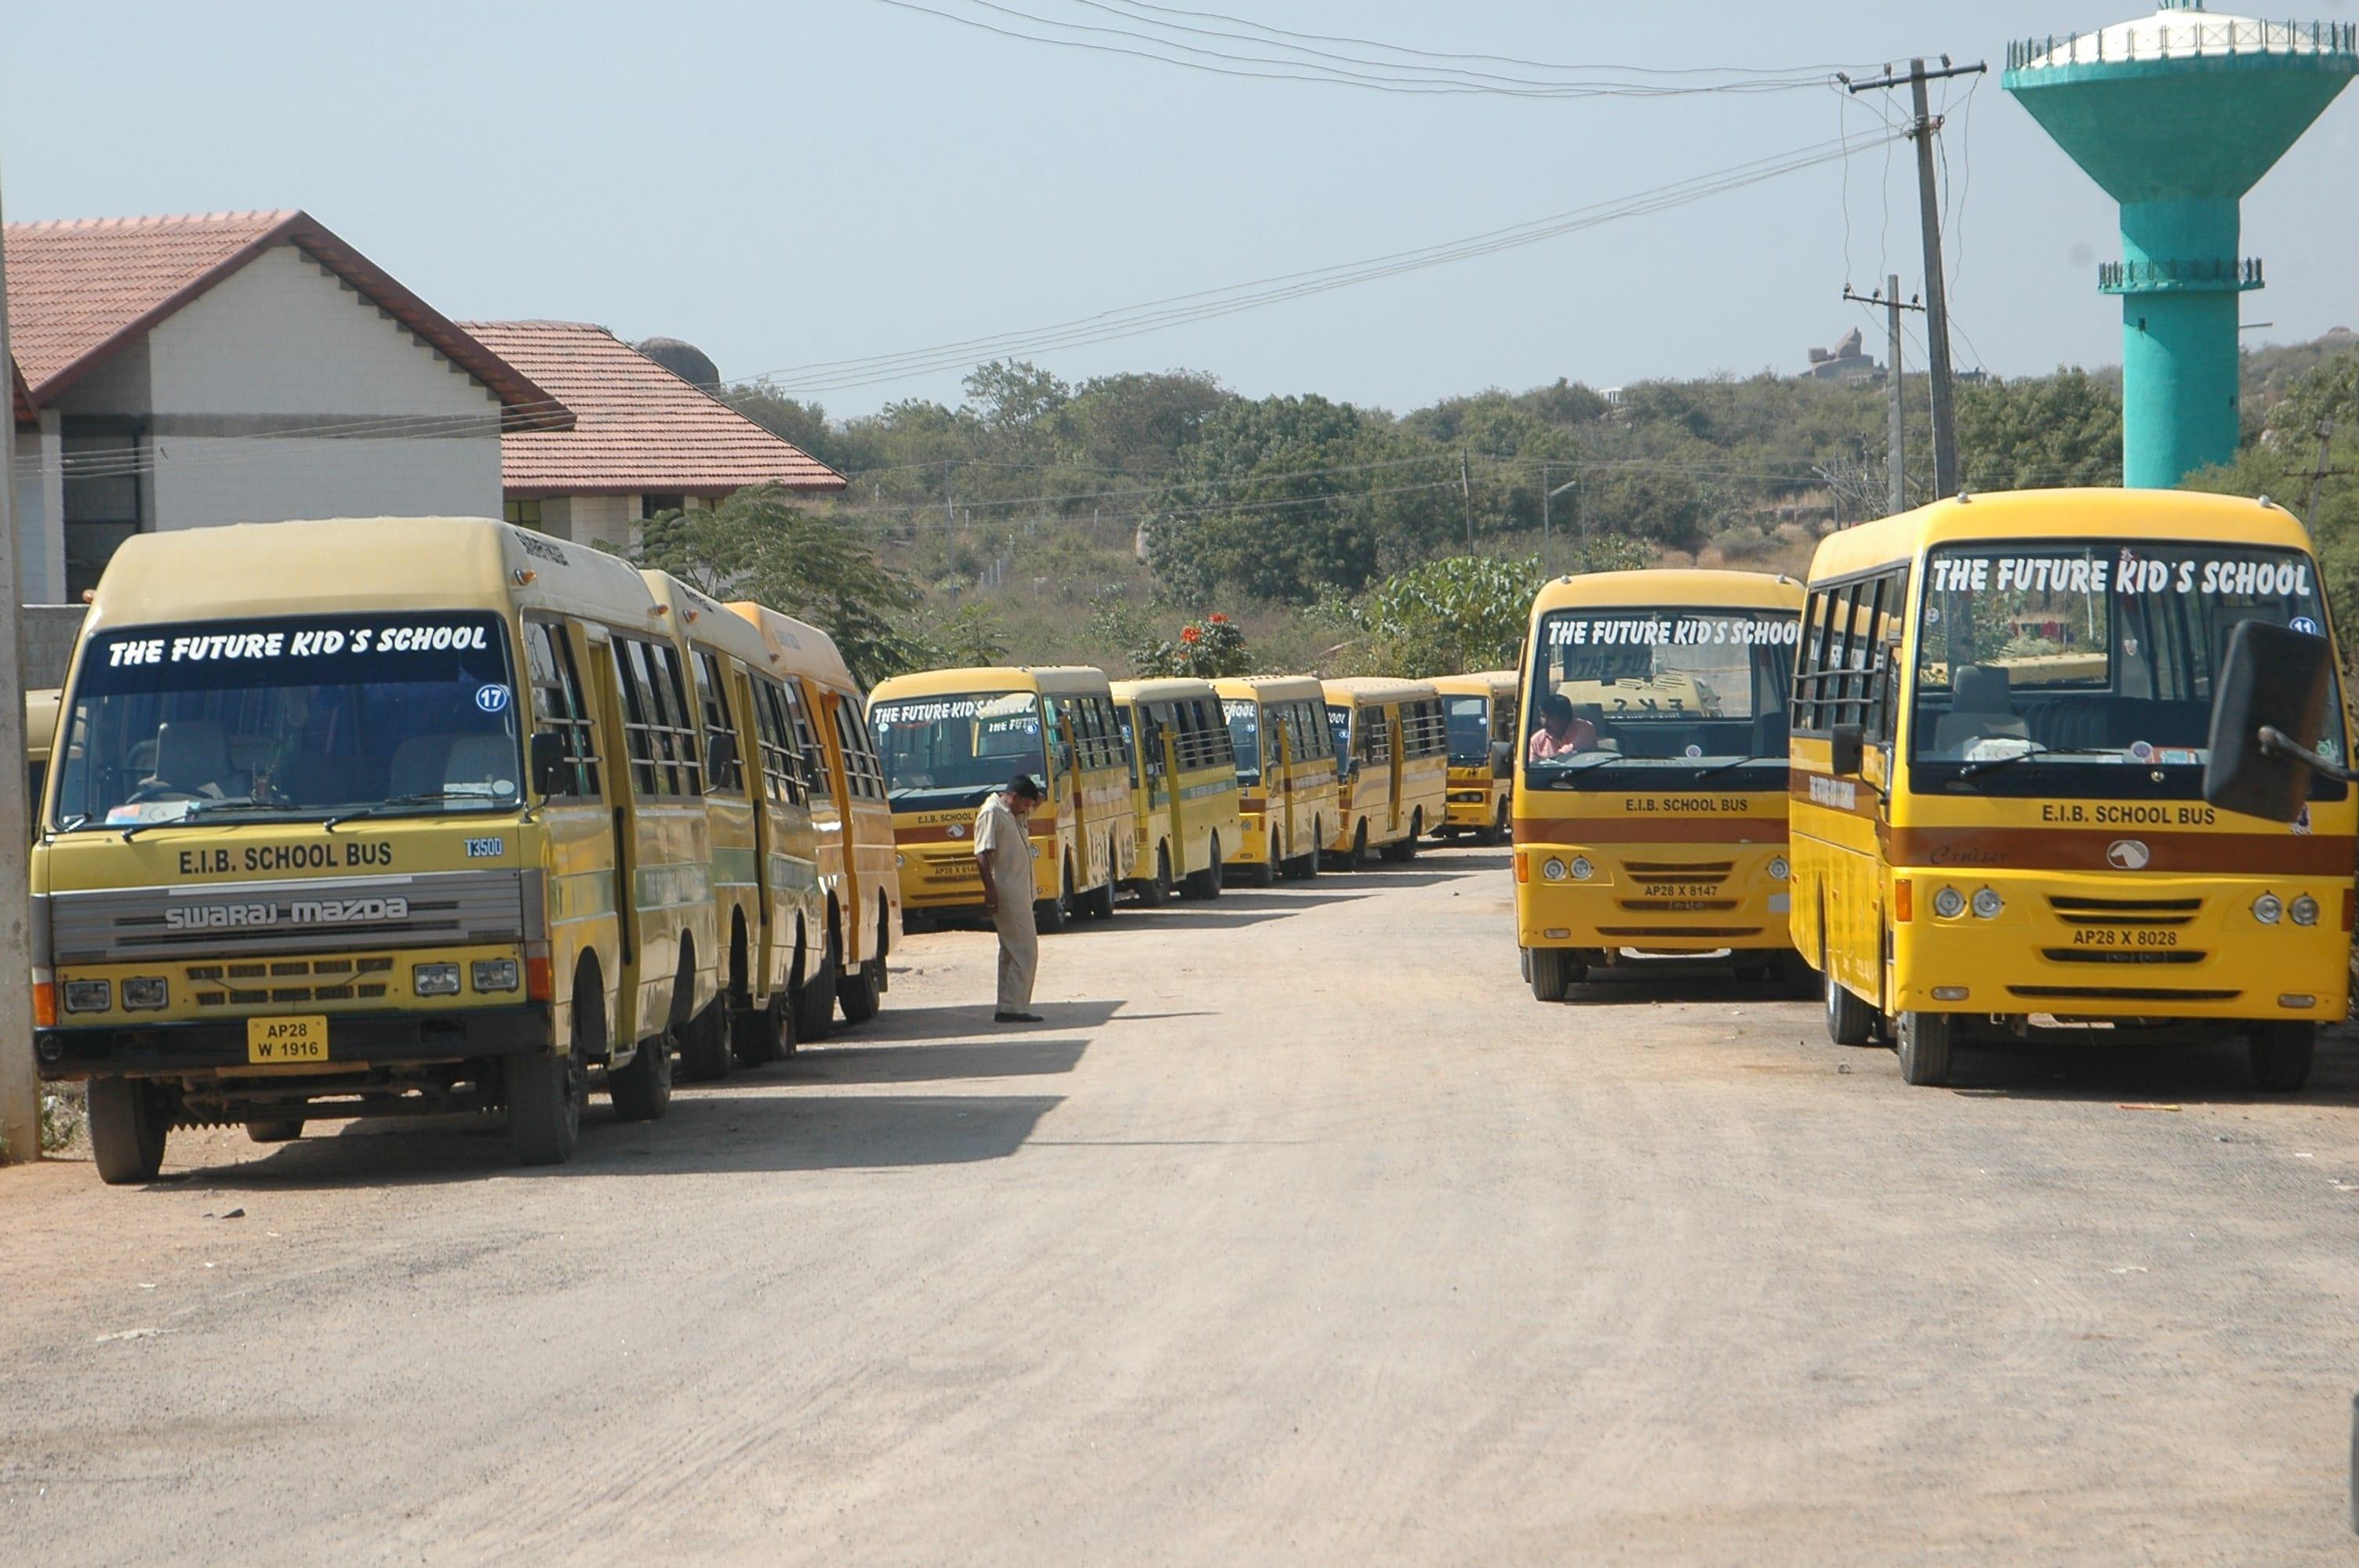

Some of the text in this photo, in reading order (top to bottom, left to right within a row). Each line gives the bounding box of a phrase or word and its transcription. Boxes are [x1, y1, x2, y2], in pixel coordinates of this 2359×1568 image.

[1934, 558, 2310, 596] THE FUTURE KID'S SCHOOL
[1549, 620, 1801, 645] THE FUTURE KID'S SCHOO
[2294, 620, 2311, 633] 11
[109, 626, 487, 666] THE FUTURE KID'S SCHOOL
[481, 689, 502, 707] 17
[875, 707, 900, 723] THE
[901, 703, 951, 721] FUTURE
[951, 700, 984, 719] KID'S
[1222, 704, 1255, 717] CHOOL
[1626, 799, 1747, 811] E.I.B. SCHOOL BUS
[941, 813, 972, 822] SCHOOL
[2042, 804, 2215, 825] E.I.B. SCHOOL BUS
[180, 841, 391, 874] E.I.B. SCHOOL BUS
[1645, 886, 1717, 896] AP28 X 8147
[2073, 930, 2177, 946] AP28 X 8028
[267, 1023, 307, 1038] AP28
[258, 1042, 318, 1056] W 1916
